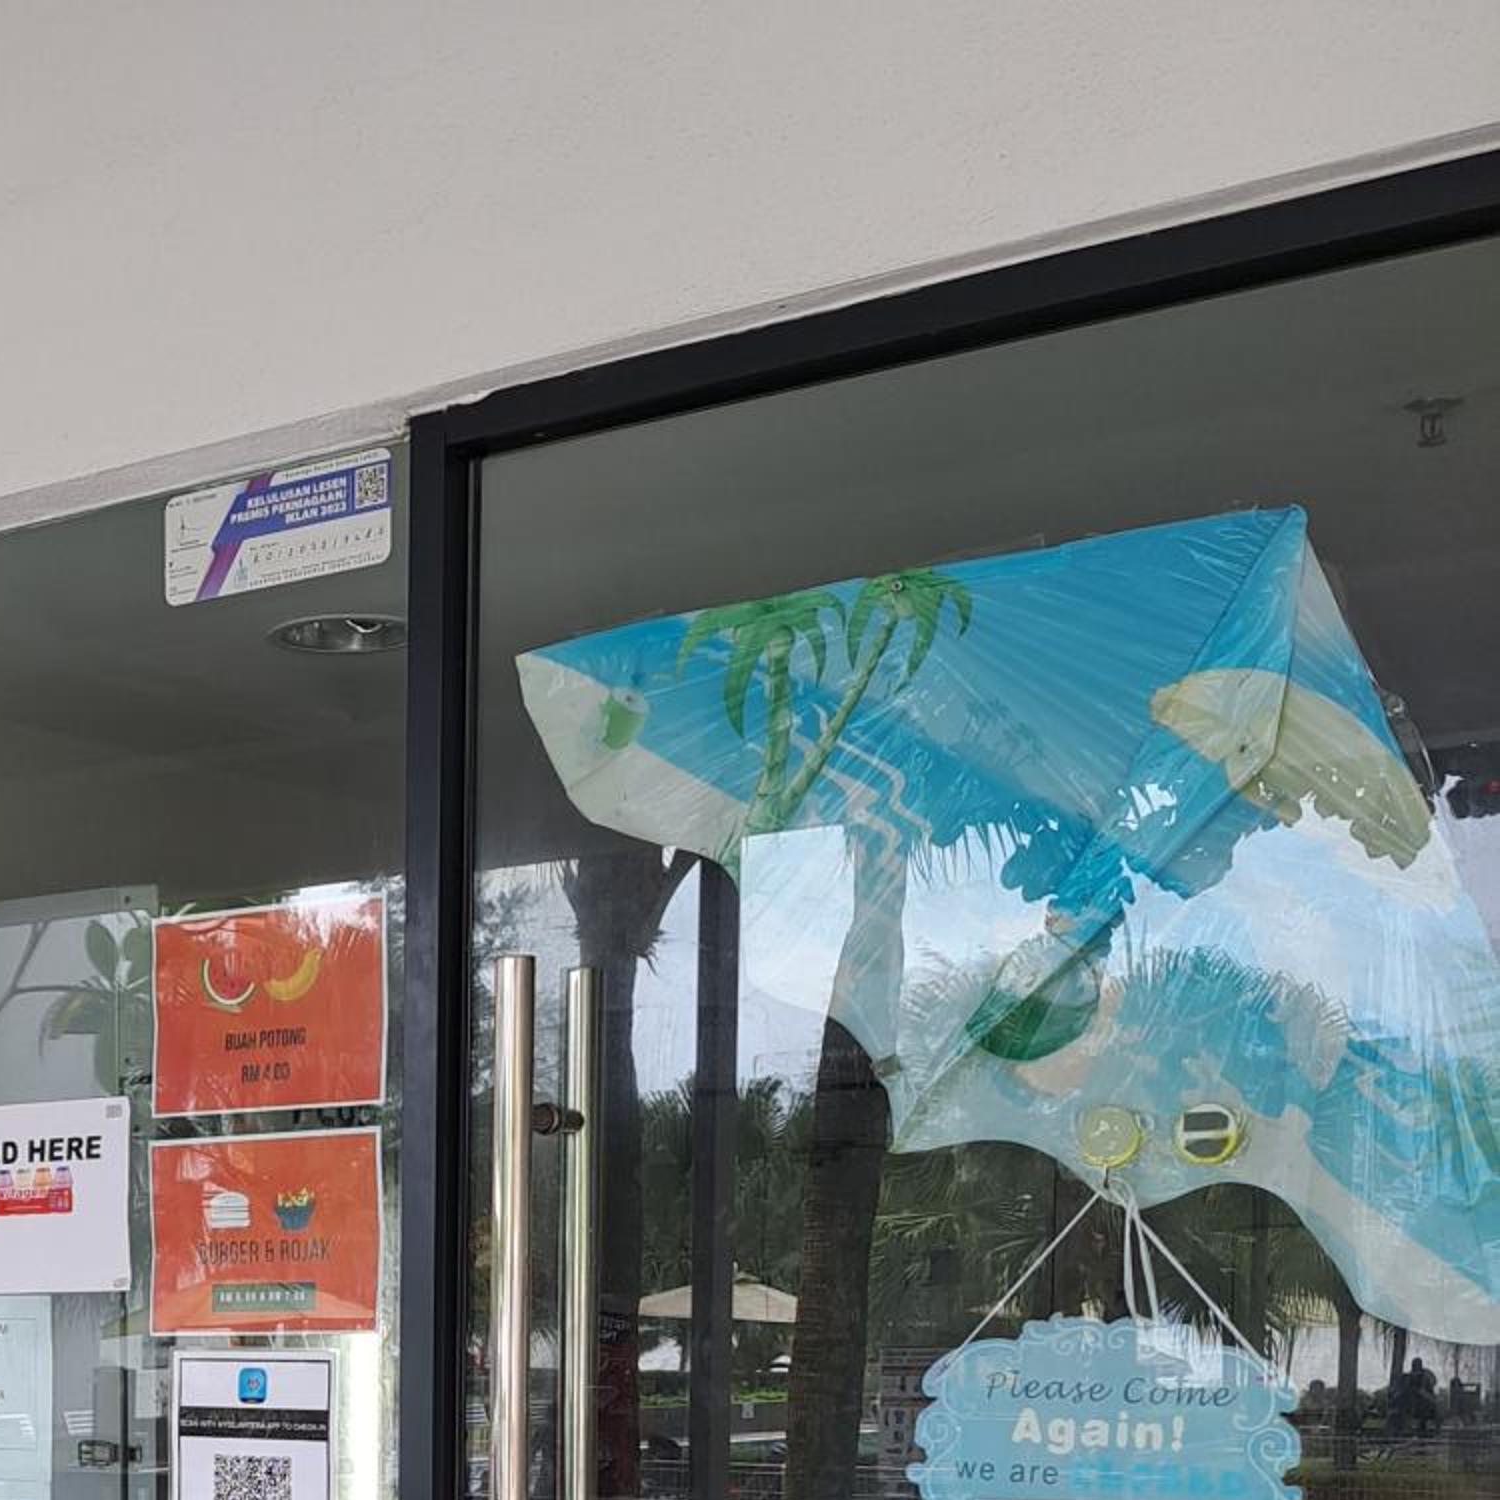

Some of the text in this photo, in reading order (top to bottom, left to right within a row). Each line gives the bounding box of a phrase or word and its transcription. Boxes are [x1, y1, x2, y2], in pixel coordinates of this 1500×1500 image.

[225, 1027, 307, 1051] BUAH POTONG
[241, 1063, 261, 1083] RM
[28, 1135, 102, 1163] HERE
[985, 1369, 1240, 1408] Please Come
[1011, 1407, 1186, 1455] Again!
[955, 1460, 996, 1482] we
[1009, 1462, 1060, 1485] are
